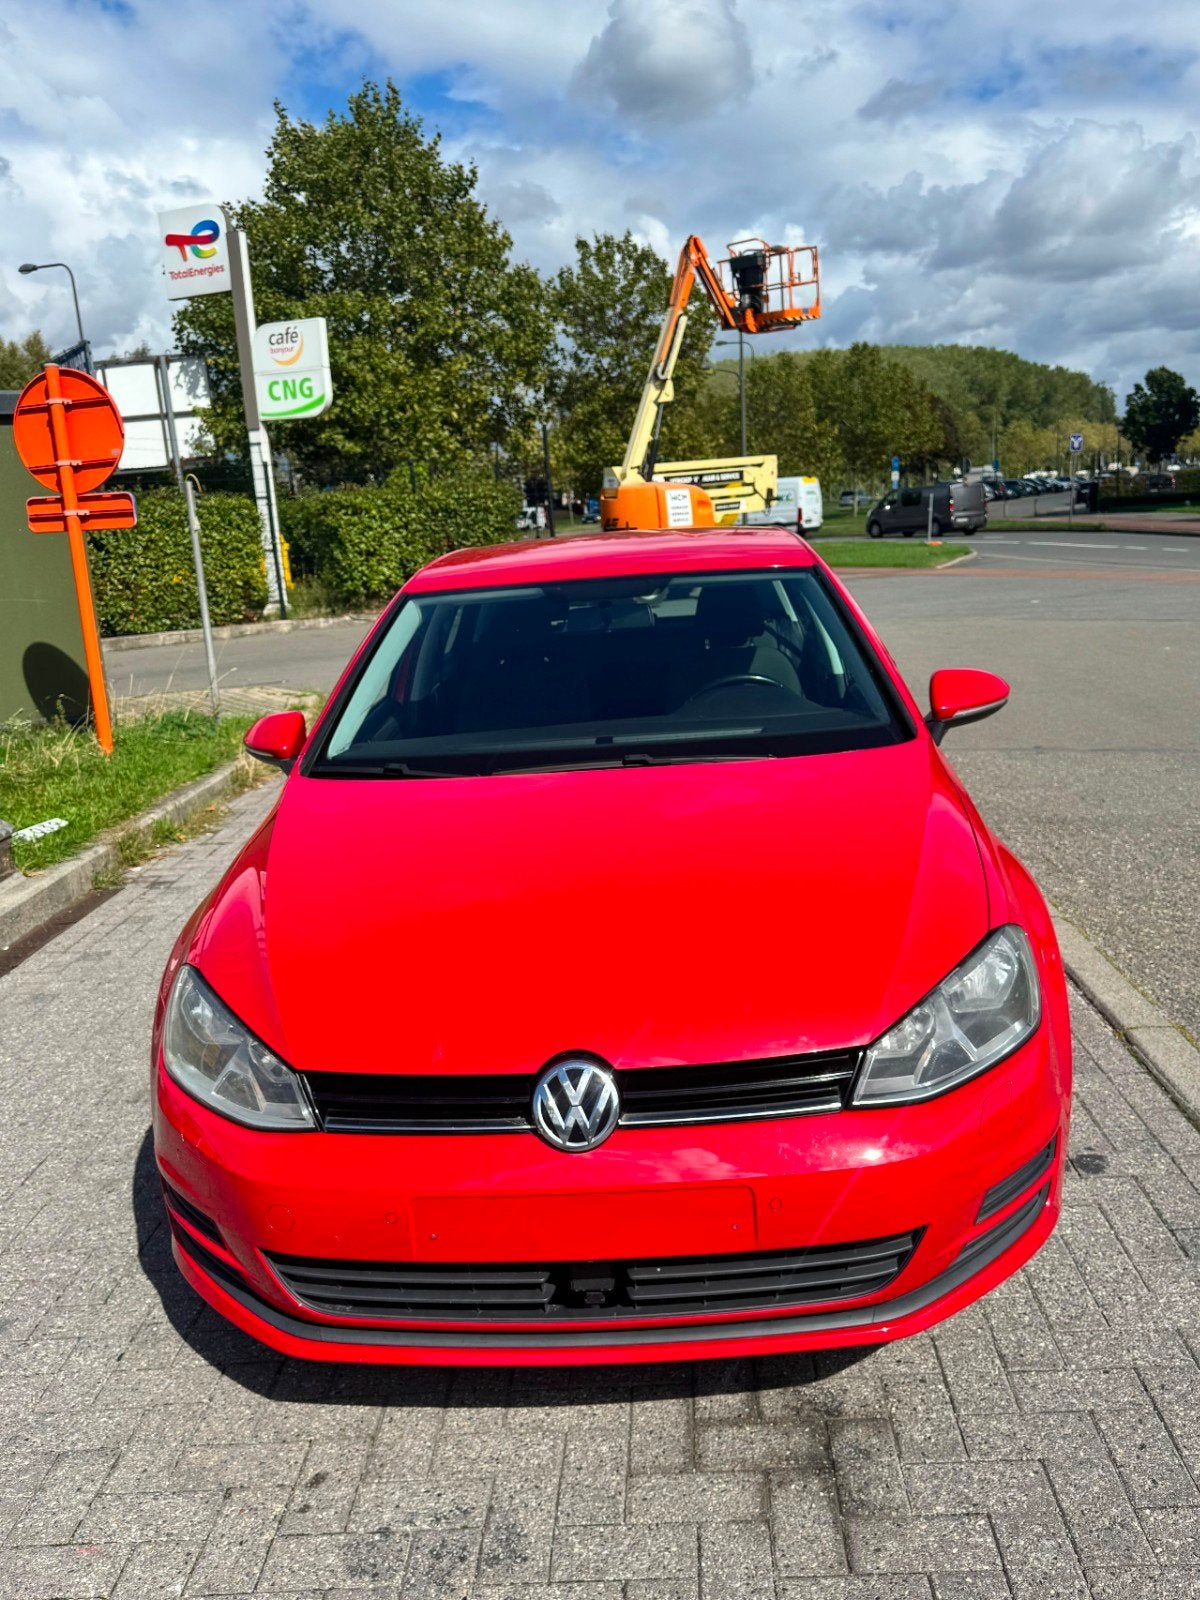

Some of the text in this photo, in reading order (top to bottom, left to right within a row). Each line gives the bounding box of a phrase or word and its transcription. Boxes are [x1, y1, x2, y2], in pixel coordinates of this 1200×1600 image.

[168, 264, 225, 281] TotalEnergies
[268, 326, 299, 345] café
[269, 346, 295, 354] bonjour
[268, 377, 314, 401] CNG
[537, 1064, 616, 1150] VW
